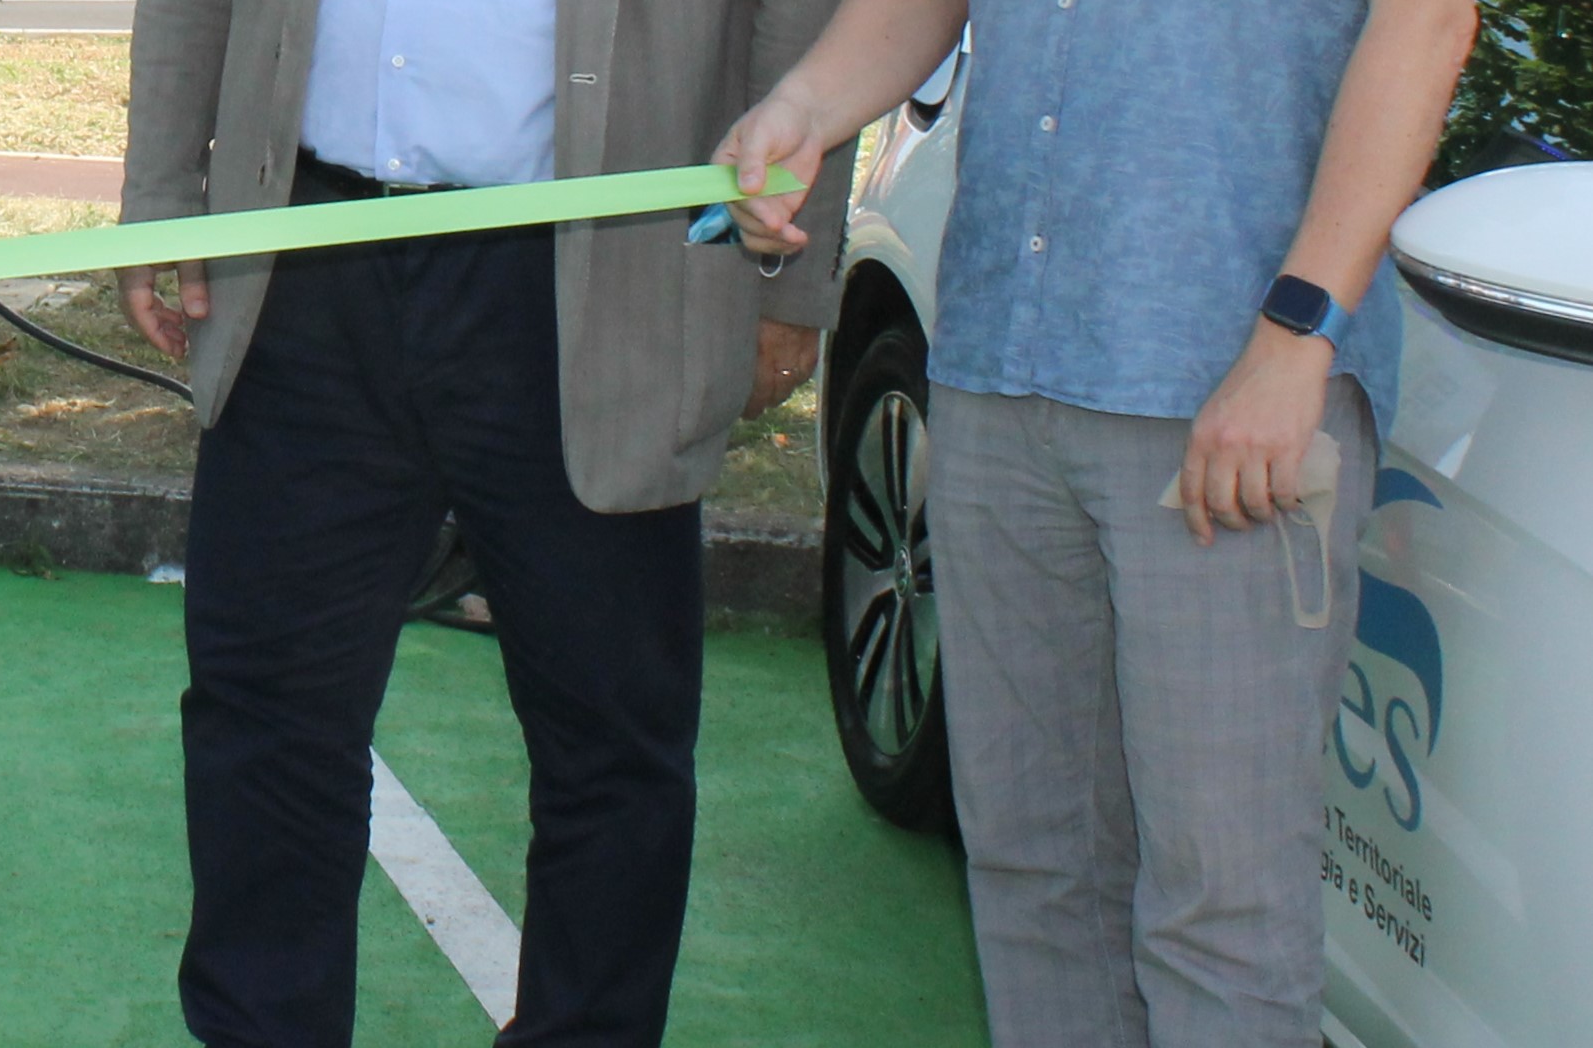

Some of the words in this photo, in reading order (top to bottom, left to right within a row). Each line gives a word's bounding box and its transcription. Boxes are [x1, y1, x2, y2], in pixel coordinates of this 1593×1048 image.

[1334, 806, 1433, 922] Territoriale
[1348, 877, 1359, 905] e
[1363, 883, 1425, 968] Servizi
